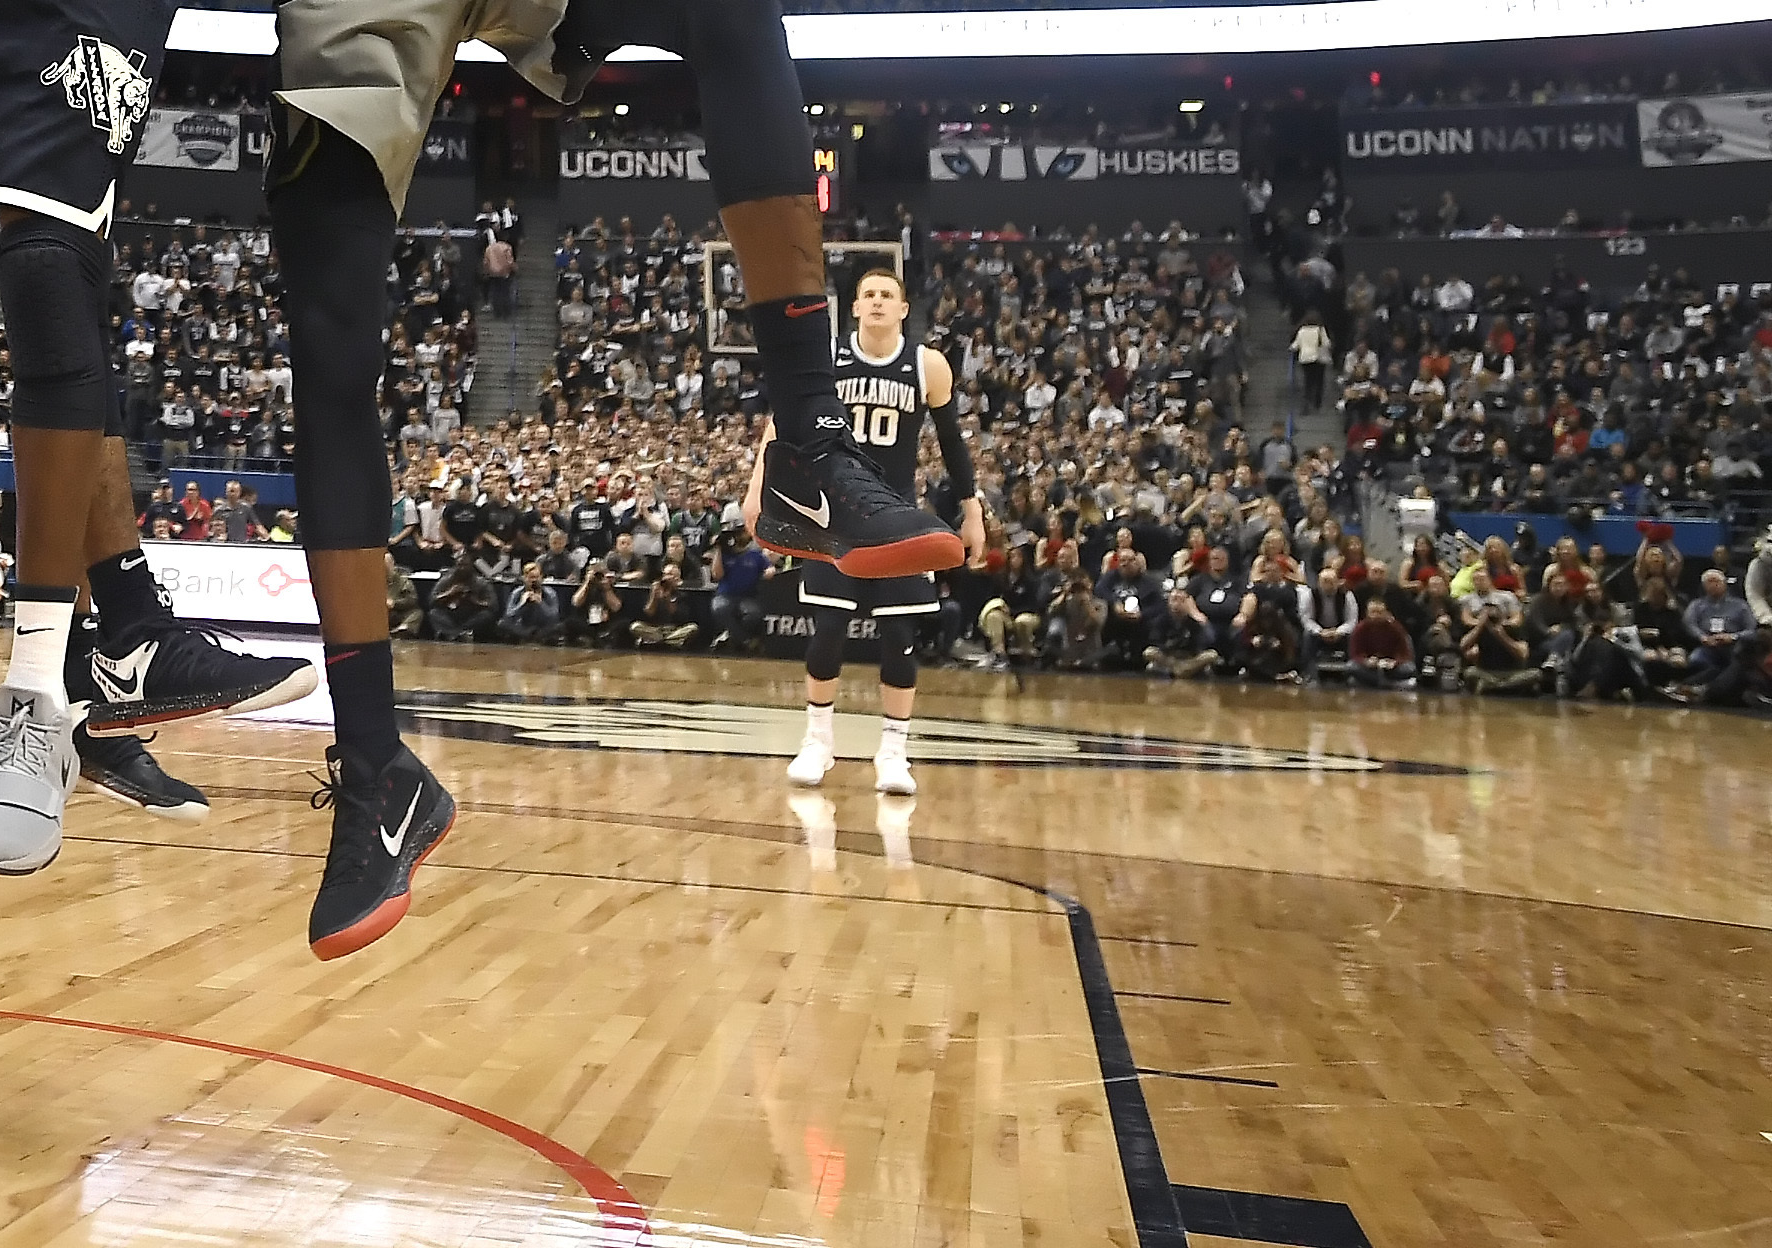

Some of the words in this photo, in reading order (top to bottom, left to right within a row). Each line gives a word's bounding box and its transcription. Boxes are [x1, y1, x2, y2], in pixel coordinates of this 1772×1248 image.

[1346, 128, 1474, 157] UCONN
[559, 149, 685, 179] UCONN
[1089, 149, 1241, 176] HUSKIES
[834, 376, 916, 414] VILLANOVA
[850, 404, 900, 446] 10
[157, 567, 246, 596] Bank
